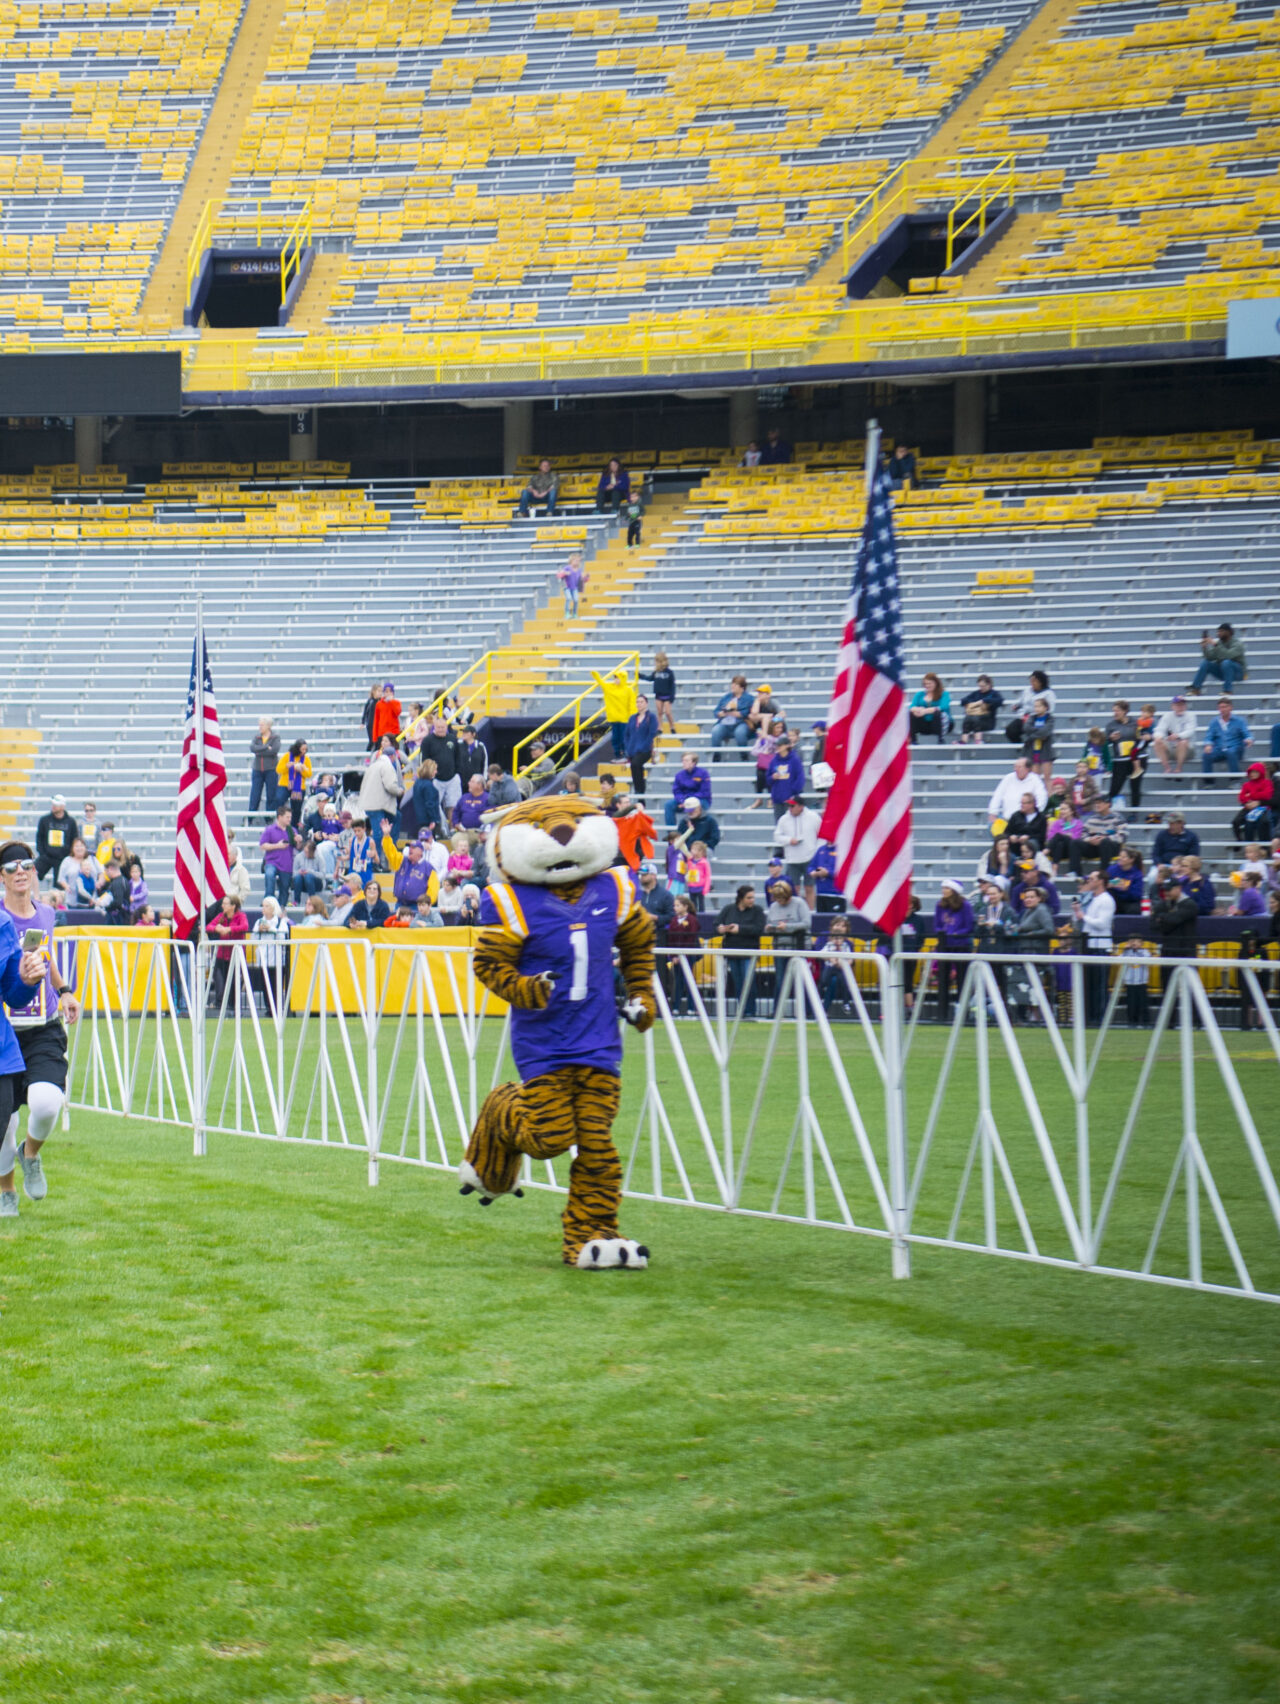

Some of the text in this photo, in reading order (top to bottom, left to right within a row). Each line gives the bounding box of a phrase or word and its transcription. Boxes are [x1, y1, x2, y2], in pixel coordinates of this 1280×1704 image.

[240, 262, 281, 273] 414 415
[569, 930, 589, 1001] 1
